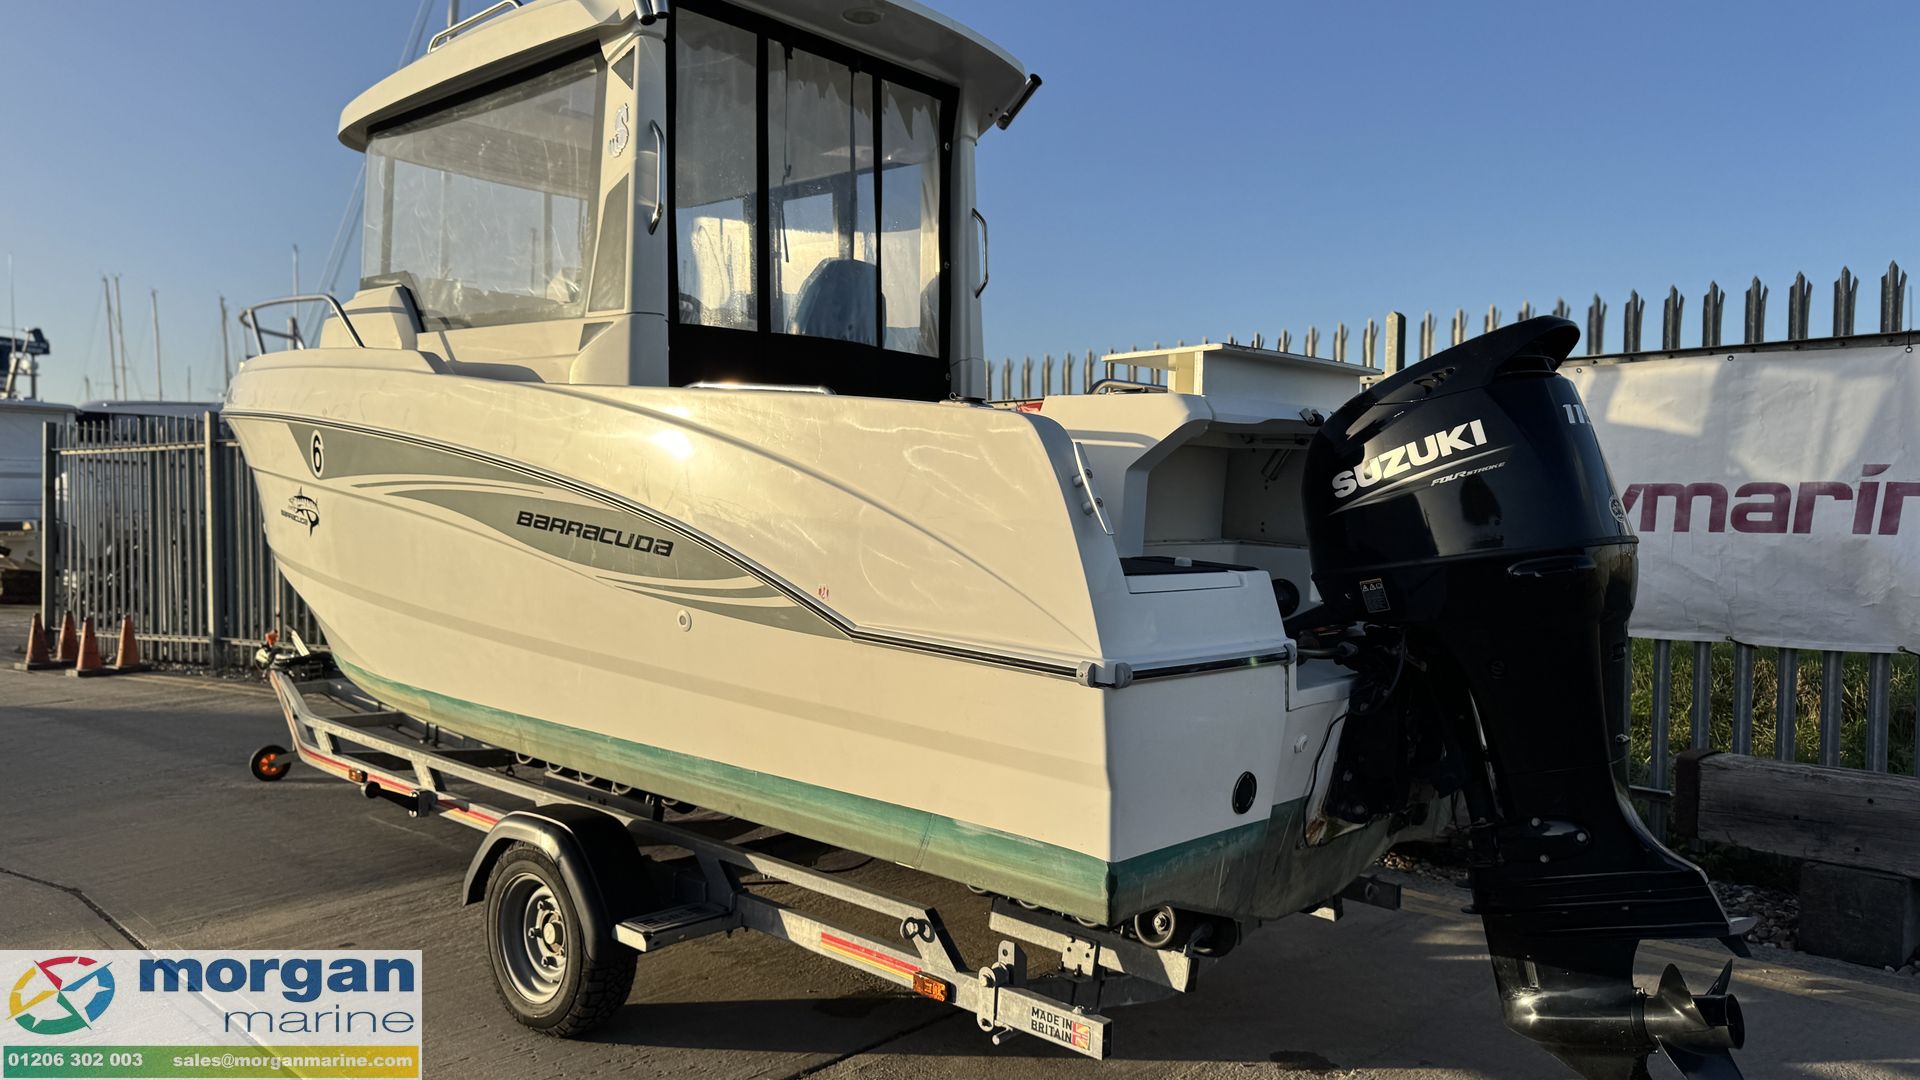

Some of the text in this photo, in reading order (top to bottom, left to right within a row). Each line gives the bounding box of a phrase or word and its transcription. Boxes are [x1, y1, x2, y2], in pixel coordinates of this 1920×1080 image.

[313, 434, 321, 473] 6
[1332, 419, 1487, 498] SUZUKI
[516, 510, 674, 557] BARRACUDA
[1031, 1006, 1072, 1031] MADE IN
[1031, 1020, 1072, 1044] BRITAIN
